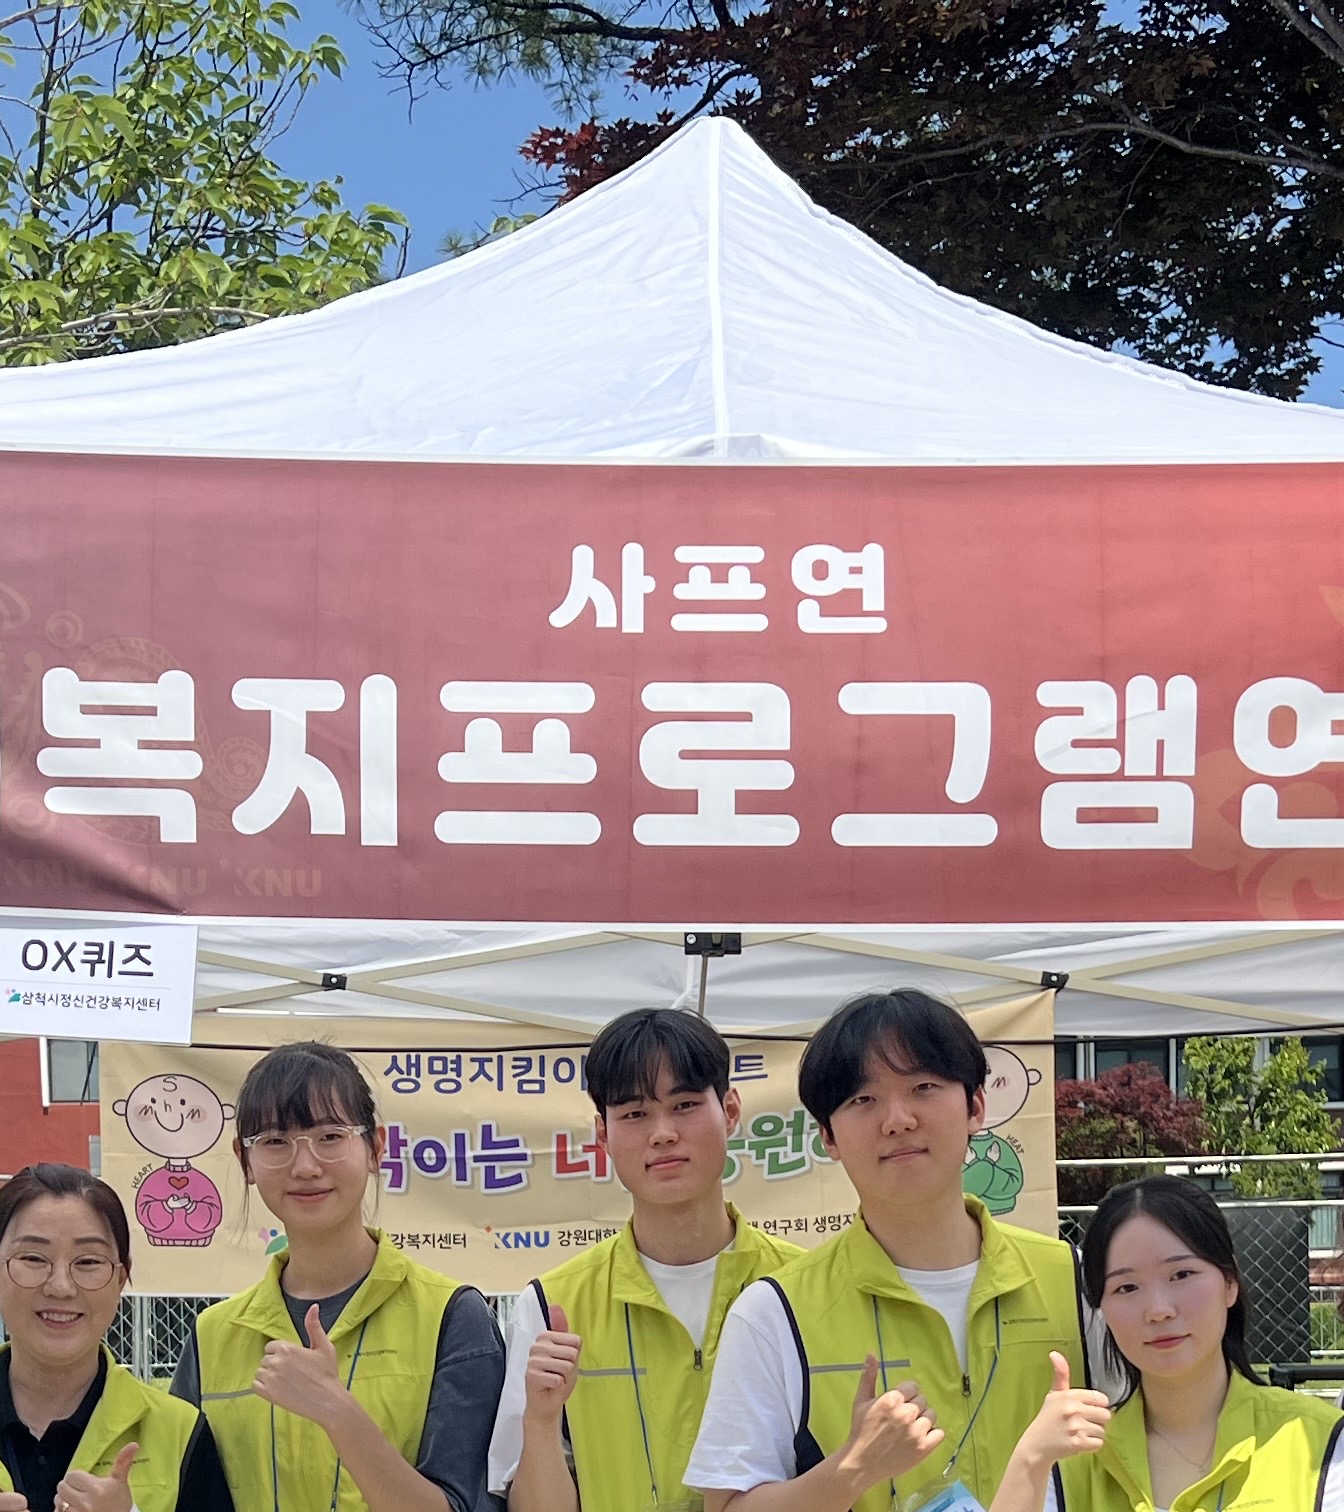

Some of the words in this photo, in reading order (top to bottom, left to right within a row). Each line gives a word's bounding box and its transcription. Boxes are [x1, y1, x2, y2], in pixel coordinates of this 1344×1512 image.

[548, 541, 889, 634] 사프연
[21, 938, 155, 980] OX퀴즈
[22, 991, 161, 1012] 삼척시정신건강복지센터
[384, 1053, 588, 1094] 생명지킴이
[494, 1231, 550, 1249] KNU
